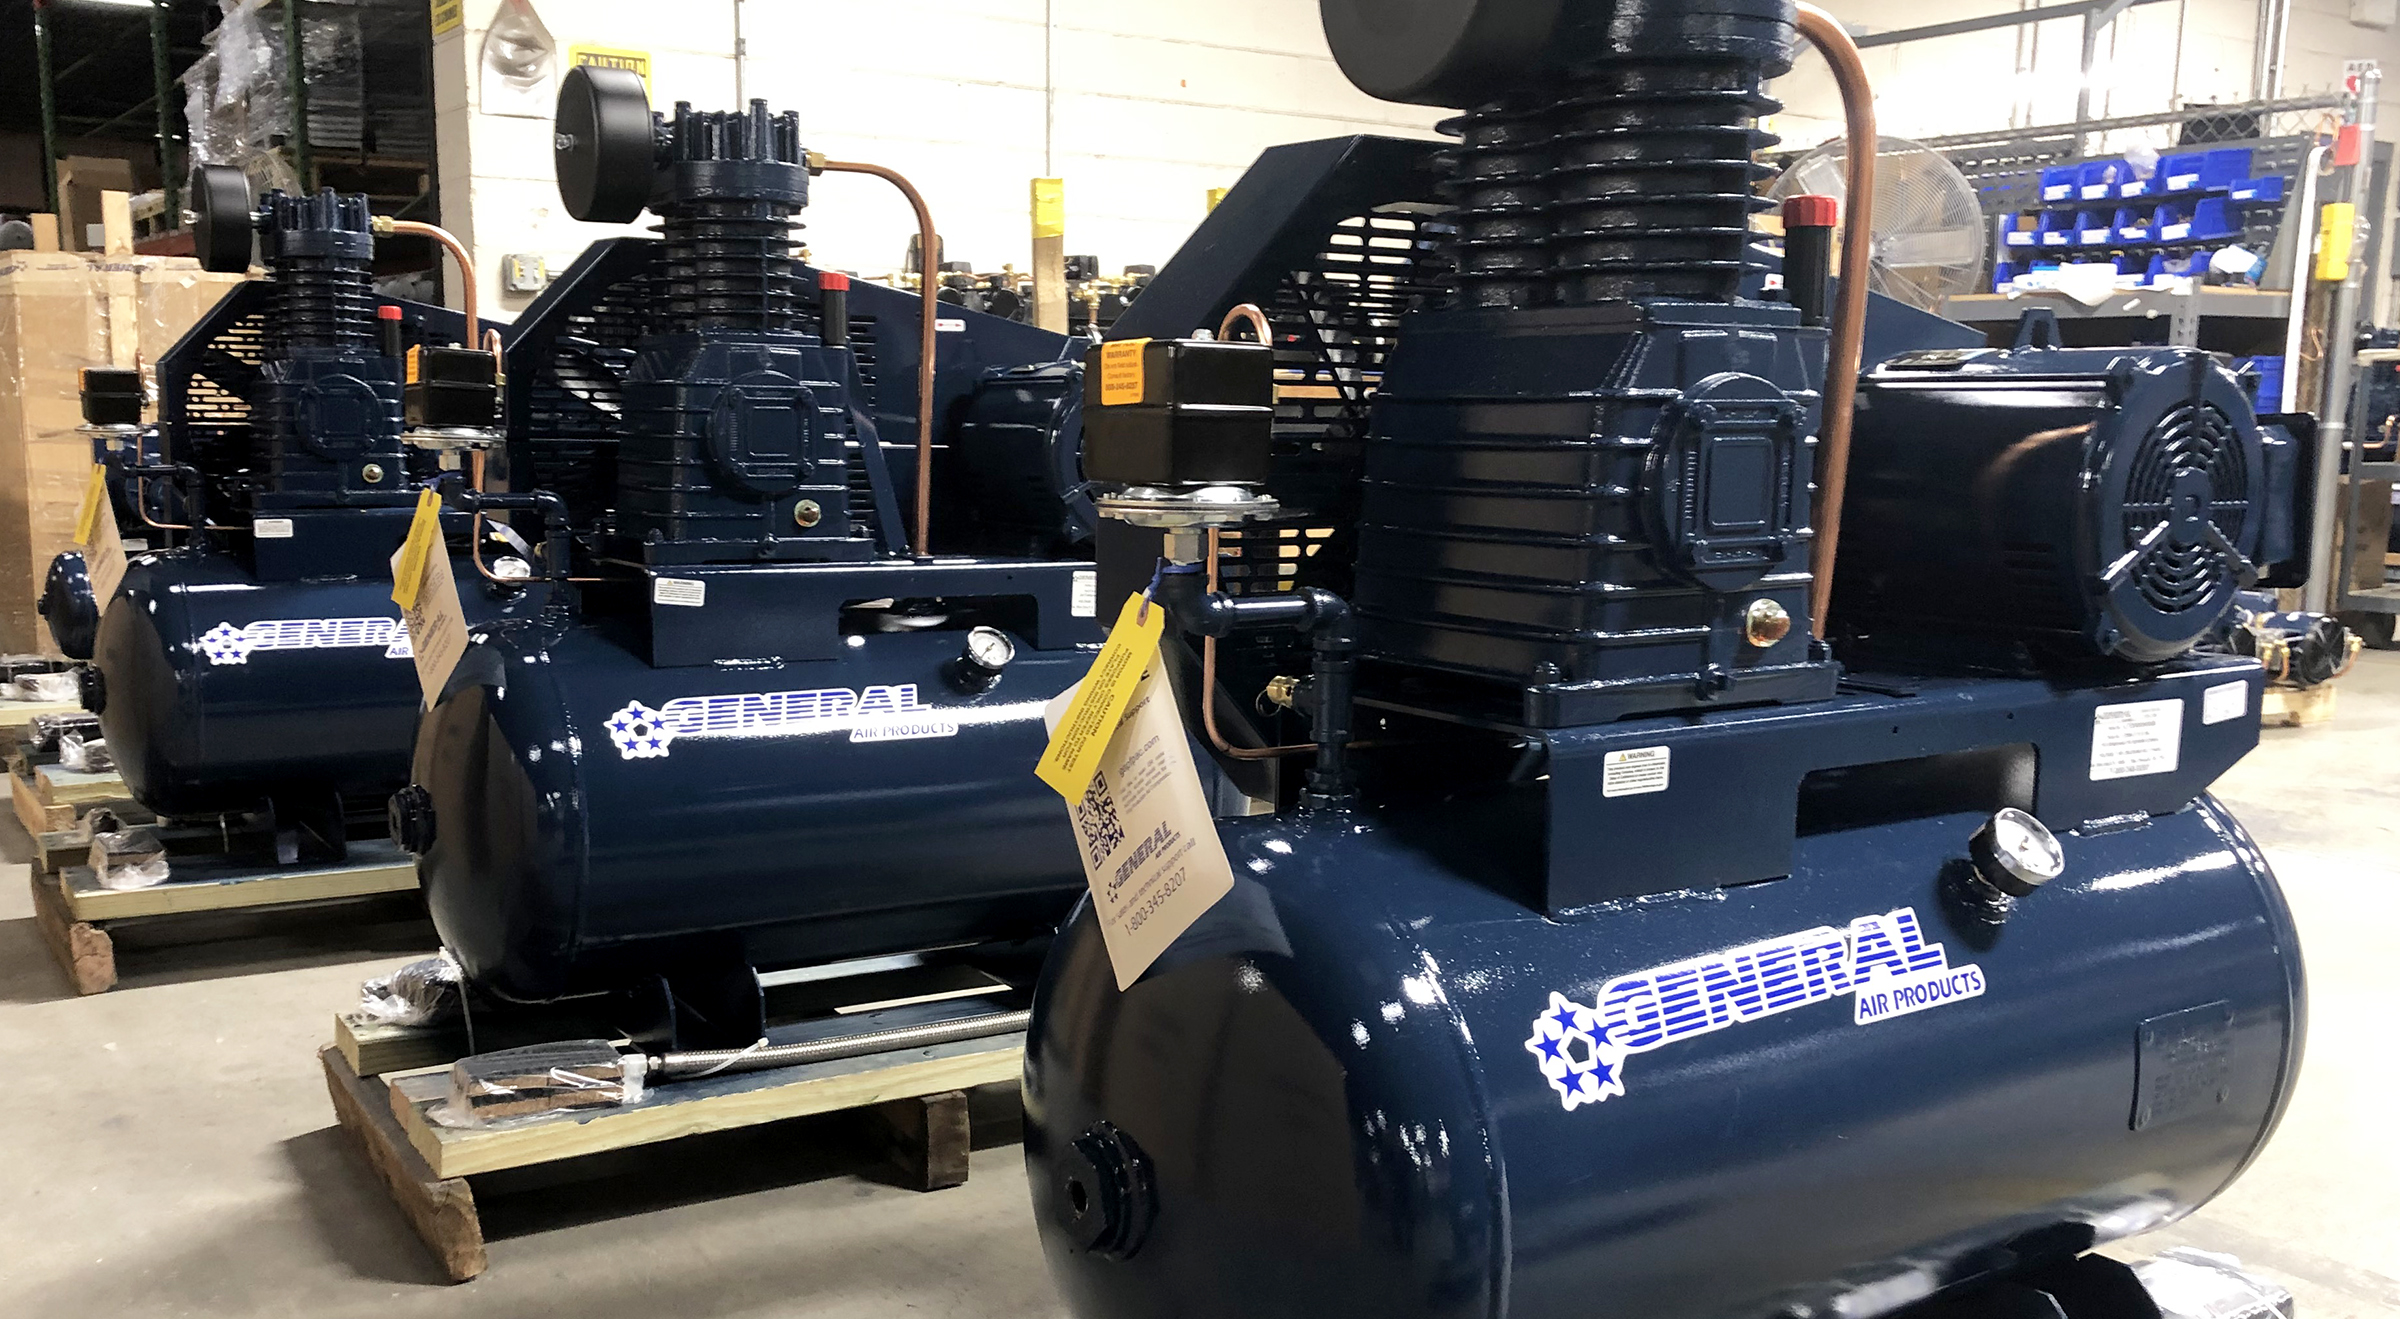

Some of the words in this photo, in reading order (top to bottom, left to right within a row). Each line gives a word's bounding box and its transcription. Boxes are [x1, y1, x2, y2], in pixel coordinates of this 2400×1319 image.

[390, 646, 409, 656] AIR
[1104, 647, 1129, 688] PURPOSES
[1114, 651, 1132, 678] MOTOR
[661, 687, 931, 734] GENERAL
[853, 727, 877, 739] AIR
[883, 722, 955, 737] PRODUCTS
[1084, 688, 1111, 735] CONNECTED
[1090, 693, 1115, 736] CAUTION
[1075, 736, 1087, 753] FOR
[1627, 750, 1655, 760] WARNING
[1114, 820, 1173, 889] GENERAL
[1183, 837, 1197, 852] call
[1124, 866, 1187, 937] 1-800-345-8207
[1604, 913, 1943, 1048] GENERAL
[1858, 988, 1889, 1019] AIR
[1894, 971, 1982, 1010] PRODUCTS
